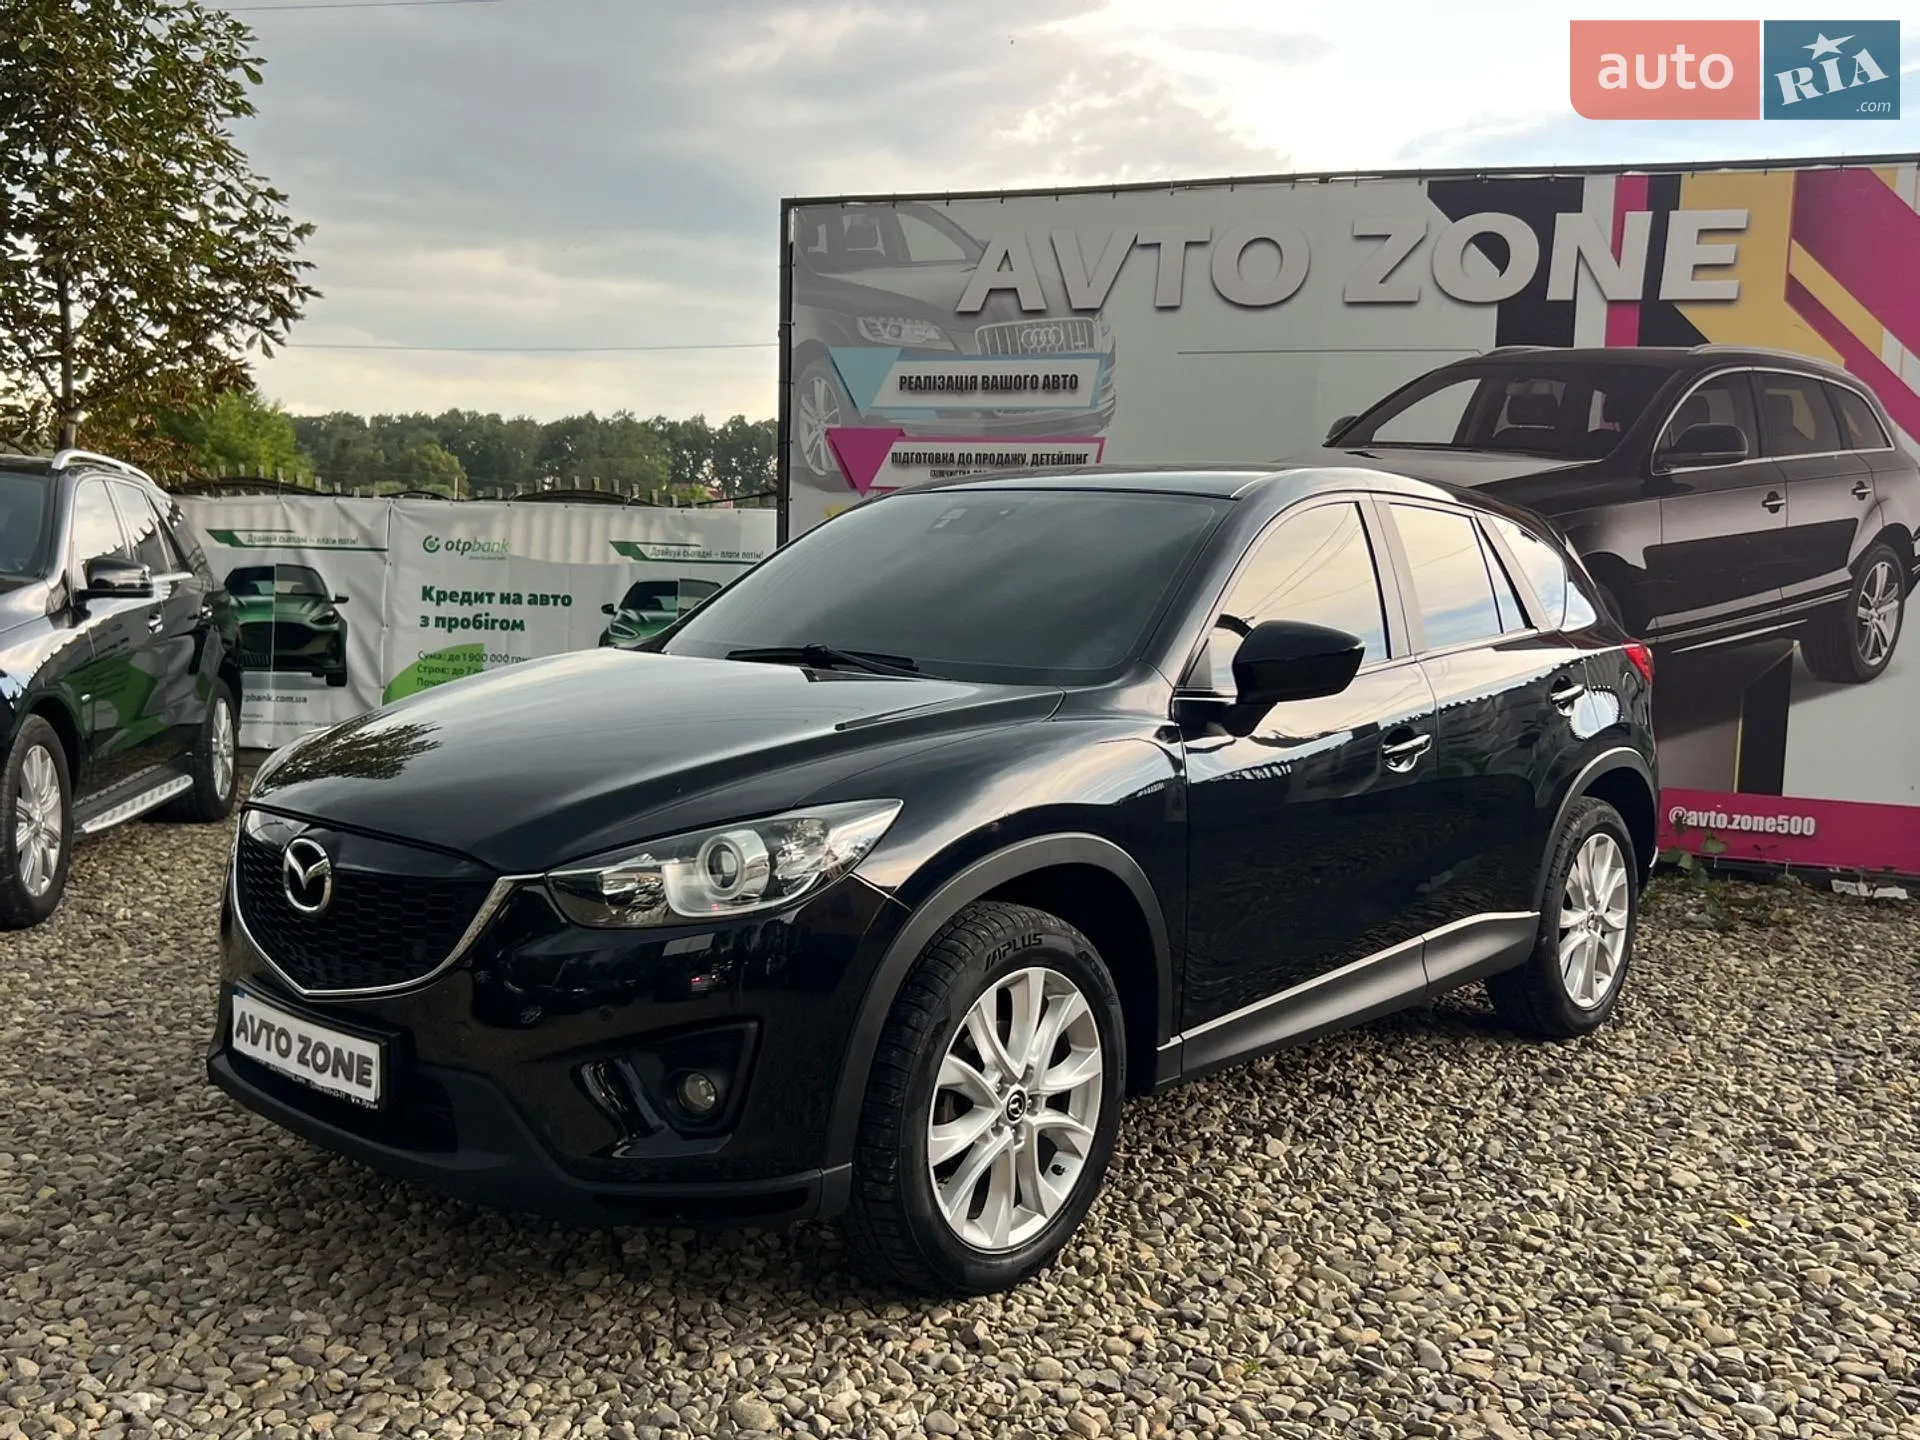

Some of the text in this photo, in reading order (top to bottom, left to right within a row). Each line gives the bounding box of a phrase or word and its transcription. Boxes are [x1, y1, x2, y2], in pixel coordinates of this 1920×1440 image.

[954, 208, 1750, 312] AVTO ZONE
[898, 373, 1079, 393] РЕАЛІЗАЦІЯ ВАШОГО АВТО
[891, 451, 956, 466] ПІДГОТОВКА
[957, 452, 973, 466] ДО
[1030, 450, 1089, 466] ДЕТЕЙЛІНГ
[444, 537, 510, 556] otpbank
[421, 585, 574, 607] Кредит на авто
[419, 612, 526, 633] з пробігом
[1668, 806, 1817, 837] @avto.zone500
[235, 1010, 373, 1089] AVTO ZONE
